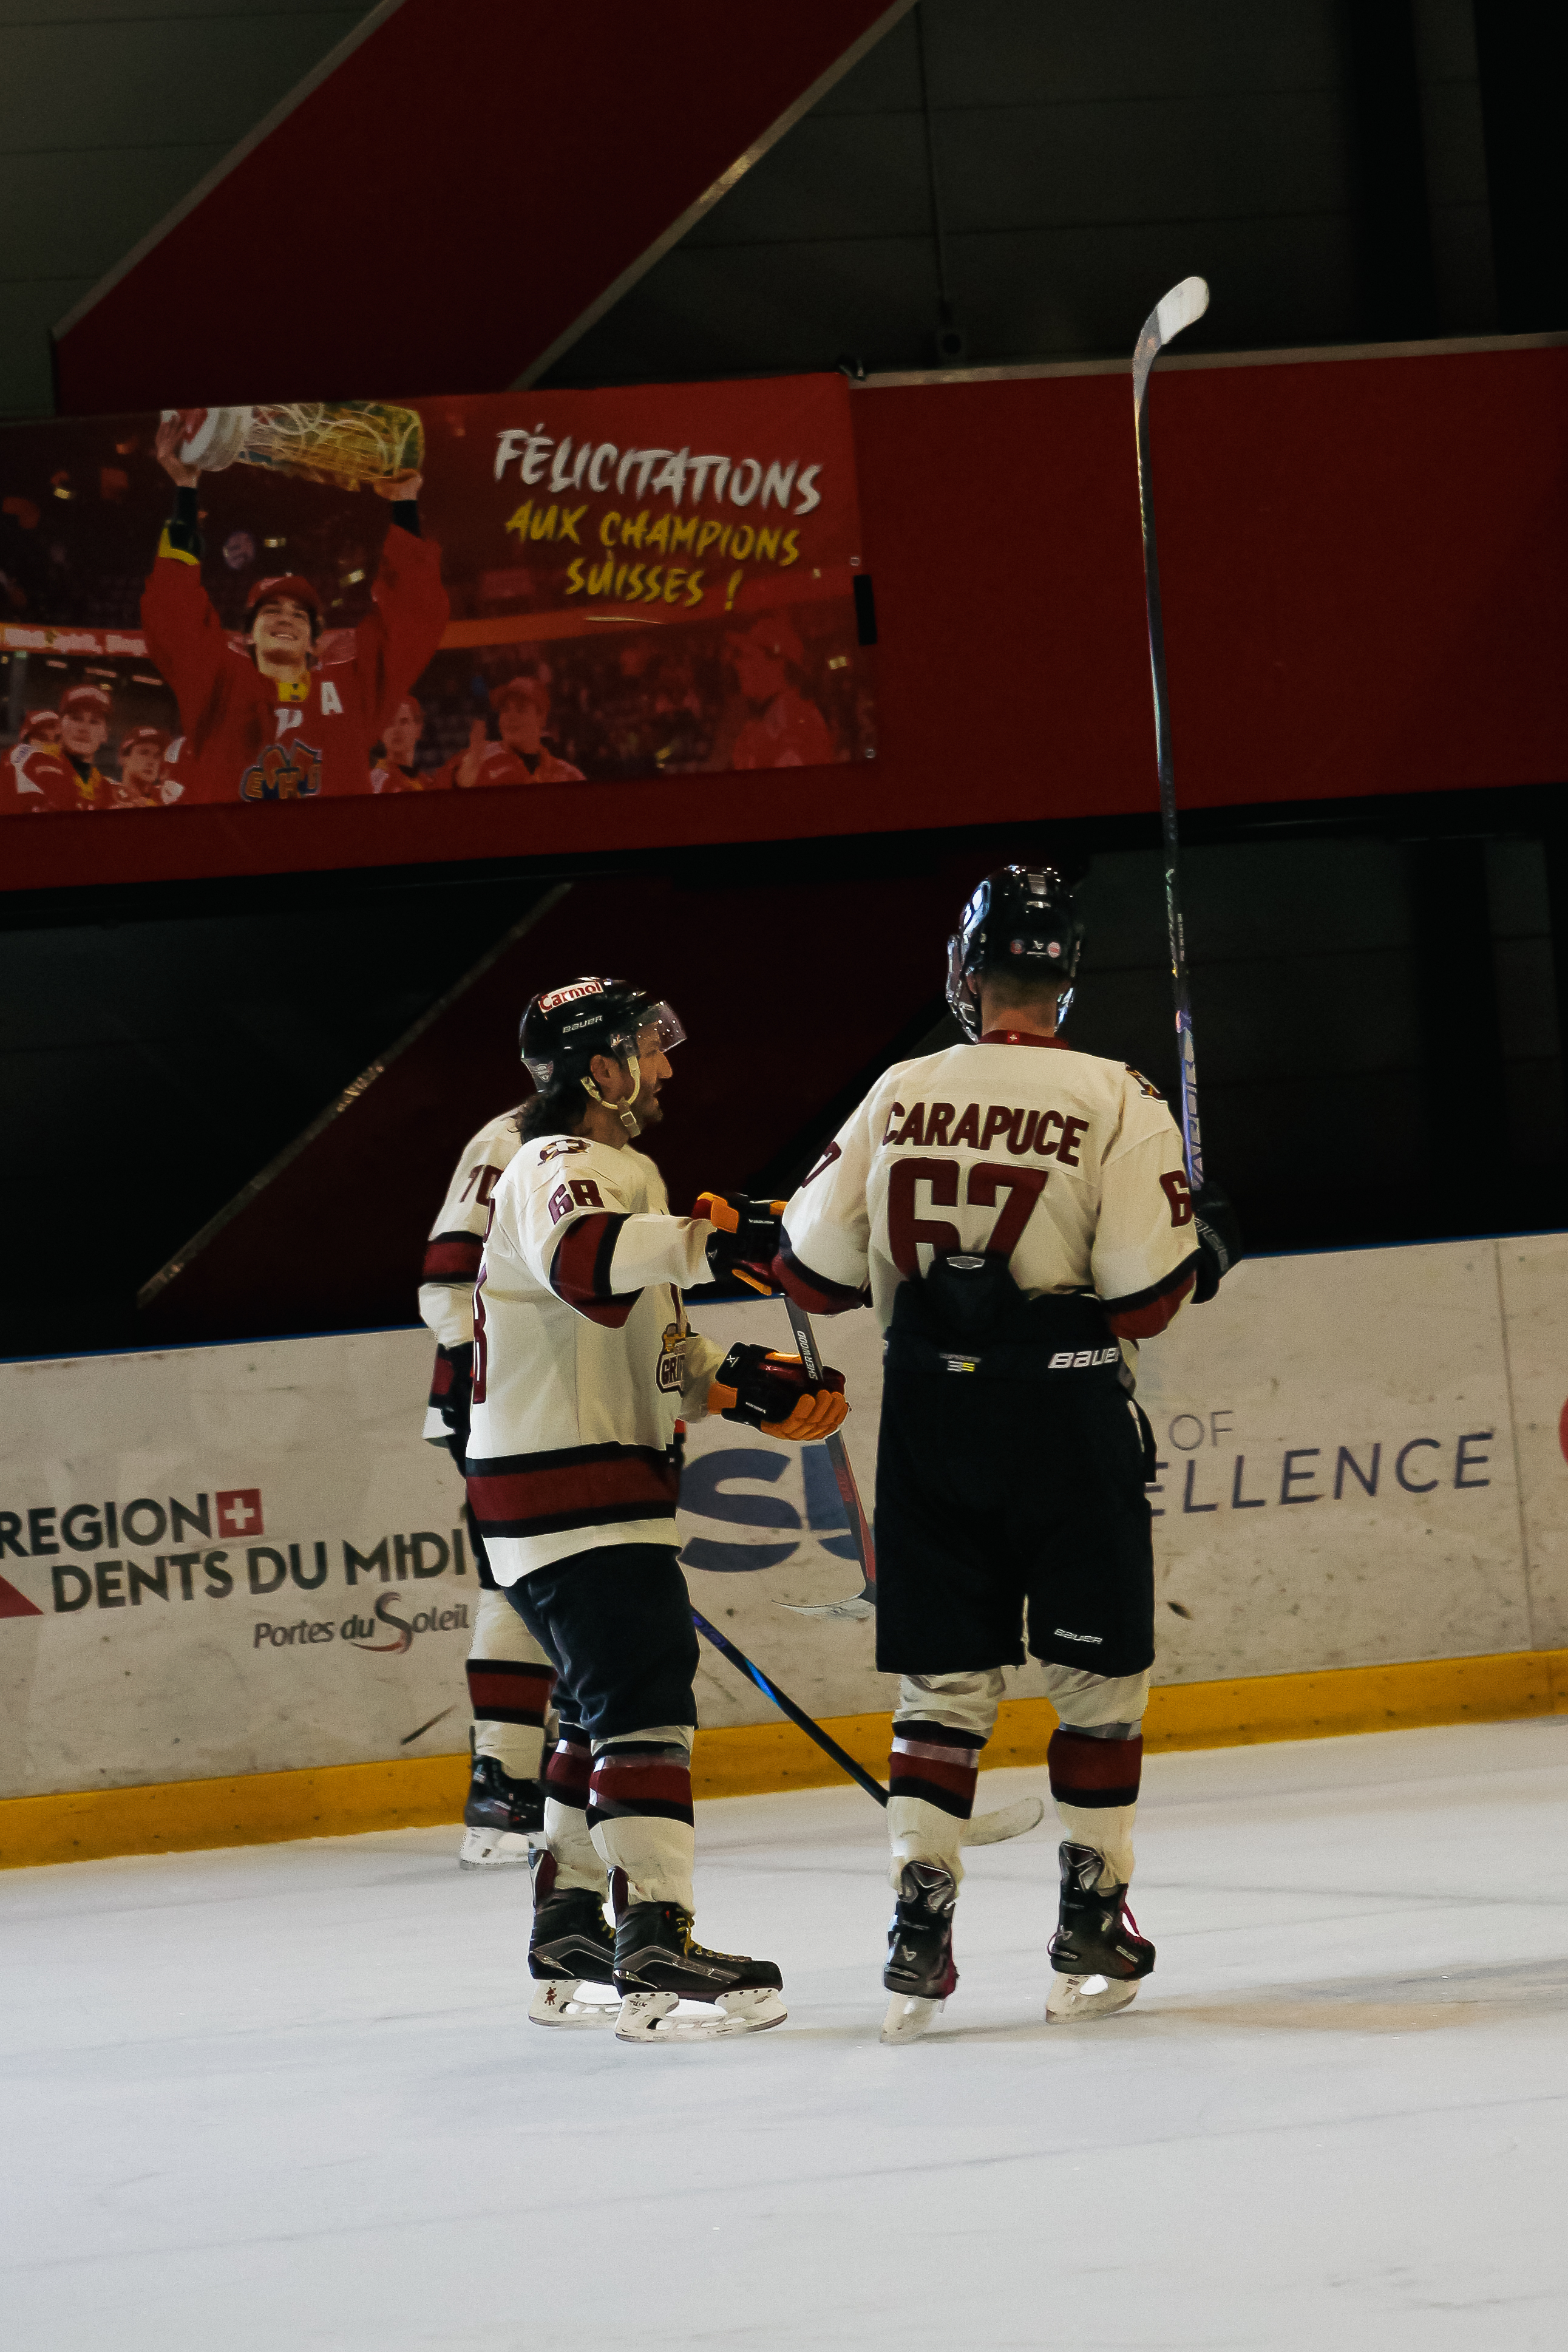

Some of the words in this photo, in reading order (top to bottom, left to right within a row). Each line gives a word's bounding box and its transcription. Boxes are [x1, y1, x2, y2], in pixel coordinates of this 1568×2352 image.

[494, 423, 824, 515] FÉLICITATIONS
[505, 500, 588, 545] AUX
[599, 510, 800, 567] CHAMPIONS
[565, 550, 704, 607] SUISSES
[724, 569, 743, 611] !
[321, 681, 344, 715] A
[540, 981, 603, 1011] Carmol
[562, 1015, 603, 1033] BAUER
[883, 1102, 1090, 1167] CARAPUCE
[548, 1180, 605, 1225] 68
[888, 1157, 1049, 1276] 67
[1169, 1410, 1233, 1450] OF
[0, 1494, 211, 1558] REGION
[52, 1551, 234, 1613] DENTS
[246, 1541, 328, 1594] DU
[253, 1620, 334, 1648] Portes
[340, 1614, 375, 1640] du
[374, 1591, 469, 1654] Soleil
[1054, 1628, 1104, 1645] BAUER
